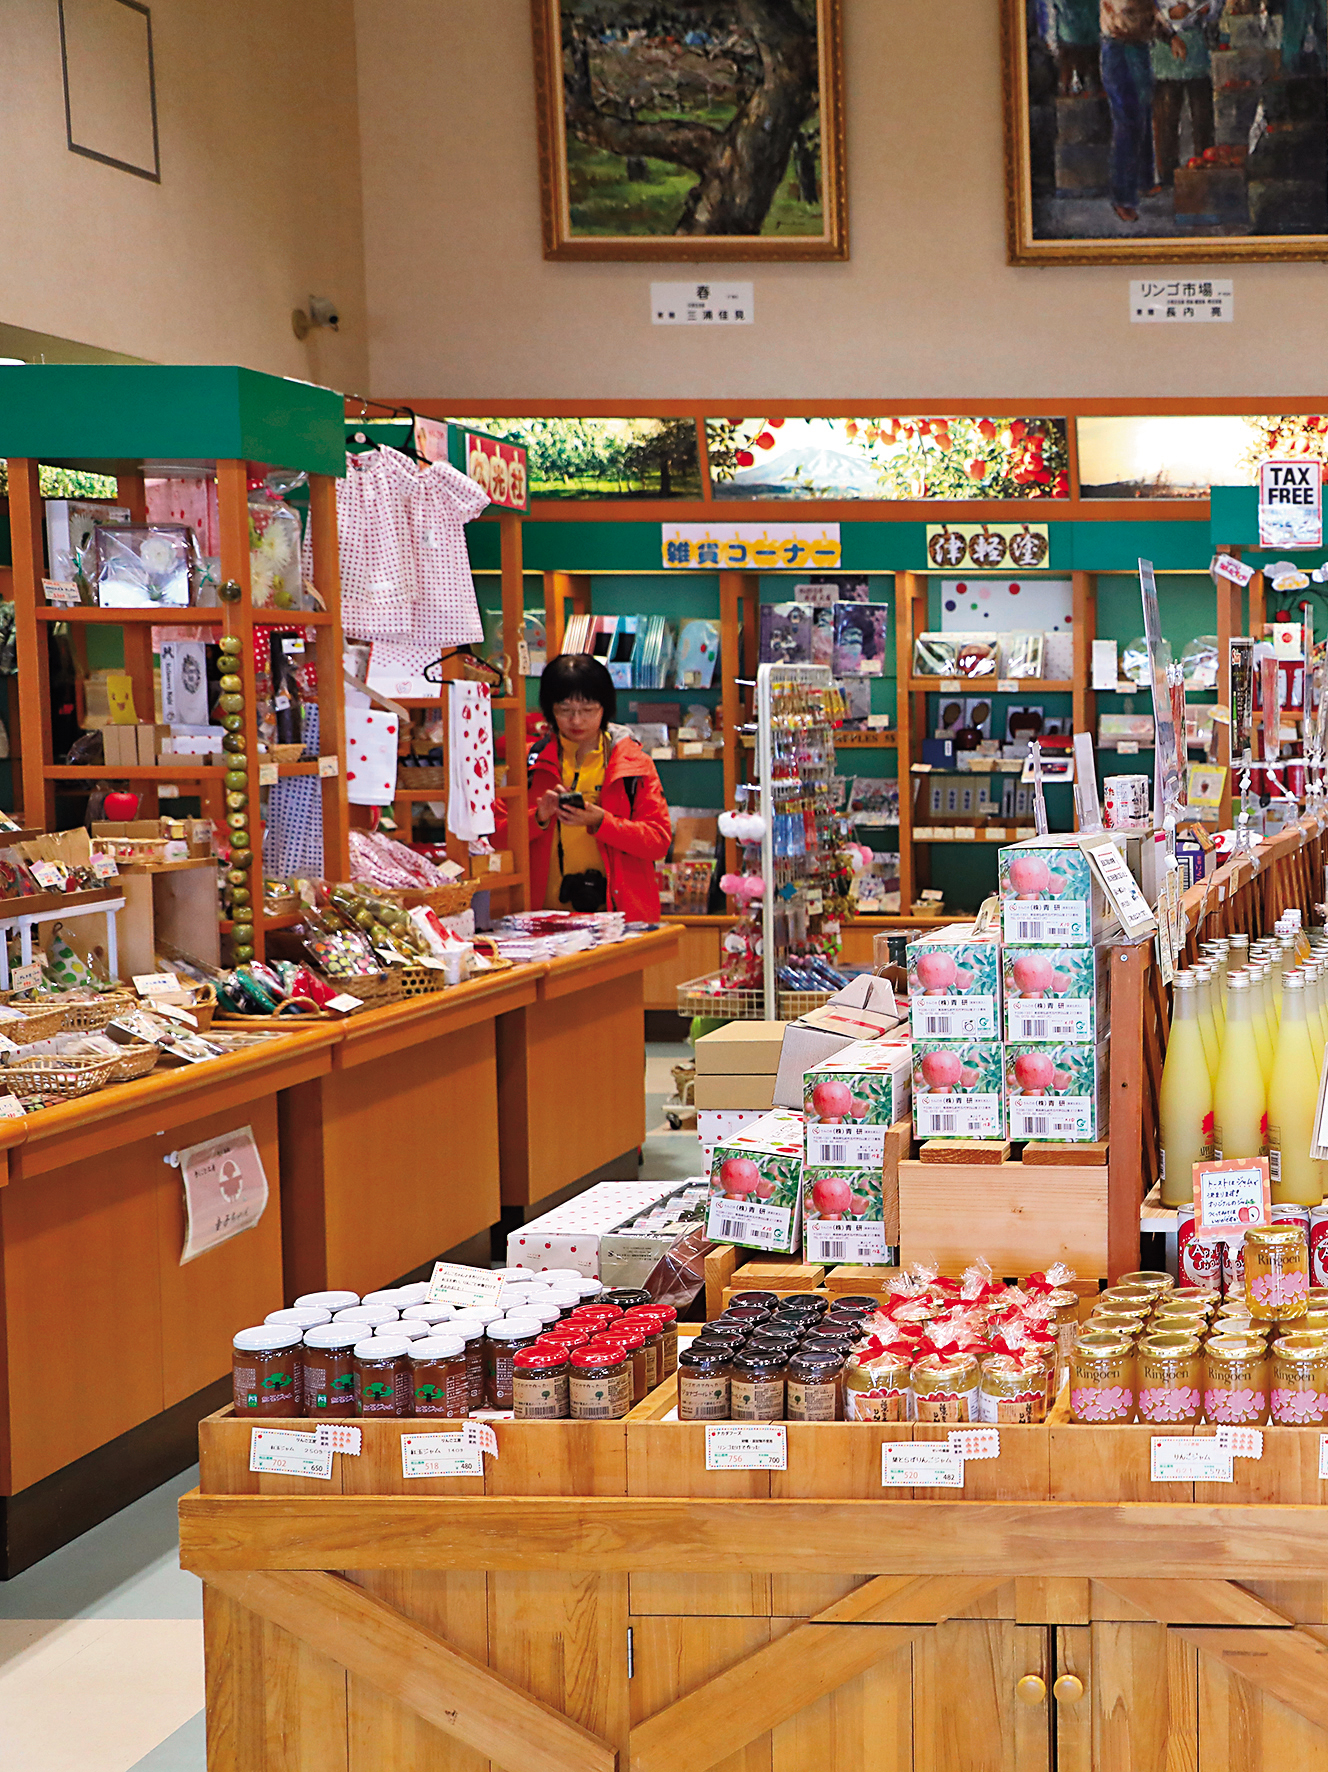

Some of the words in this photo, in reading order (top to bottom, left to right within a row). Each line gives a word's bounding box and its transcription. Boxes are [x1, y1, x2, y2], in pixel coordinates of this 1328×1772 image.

[697, 285, 710, 300] 春
[1141, 282, 1213, 298] リンゴ市場
[1270, 467, 1310, 486] TAX
[1268, 488, 1314, 505] FREE
[667, 541, 837, 565] 雑貨コーナー
[935, 533, 1040, 565] 津軽塗
[1257, 1253, 1301, 1267] Ringoen
[1076, 1366, 1120, 1383] Ringoen
[1144, 1366, 1189, 1384] Ringoen
[1208, 1367, 1251, 1384] Ringoen
[1273, 1367, 1315, 1385] Ringoen
[272, 1459, 287, 1467] 702
[425, 1462, 439, 1470] 518
[728, 1455, 743, 1463] 756
[904, 1471, 919, 1479] 520
